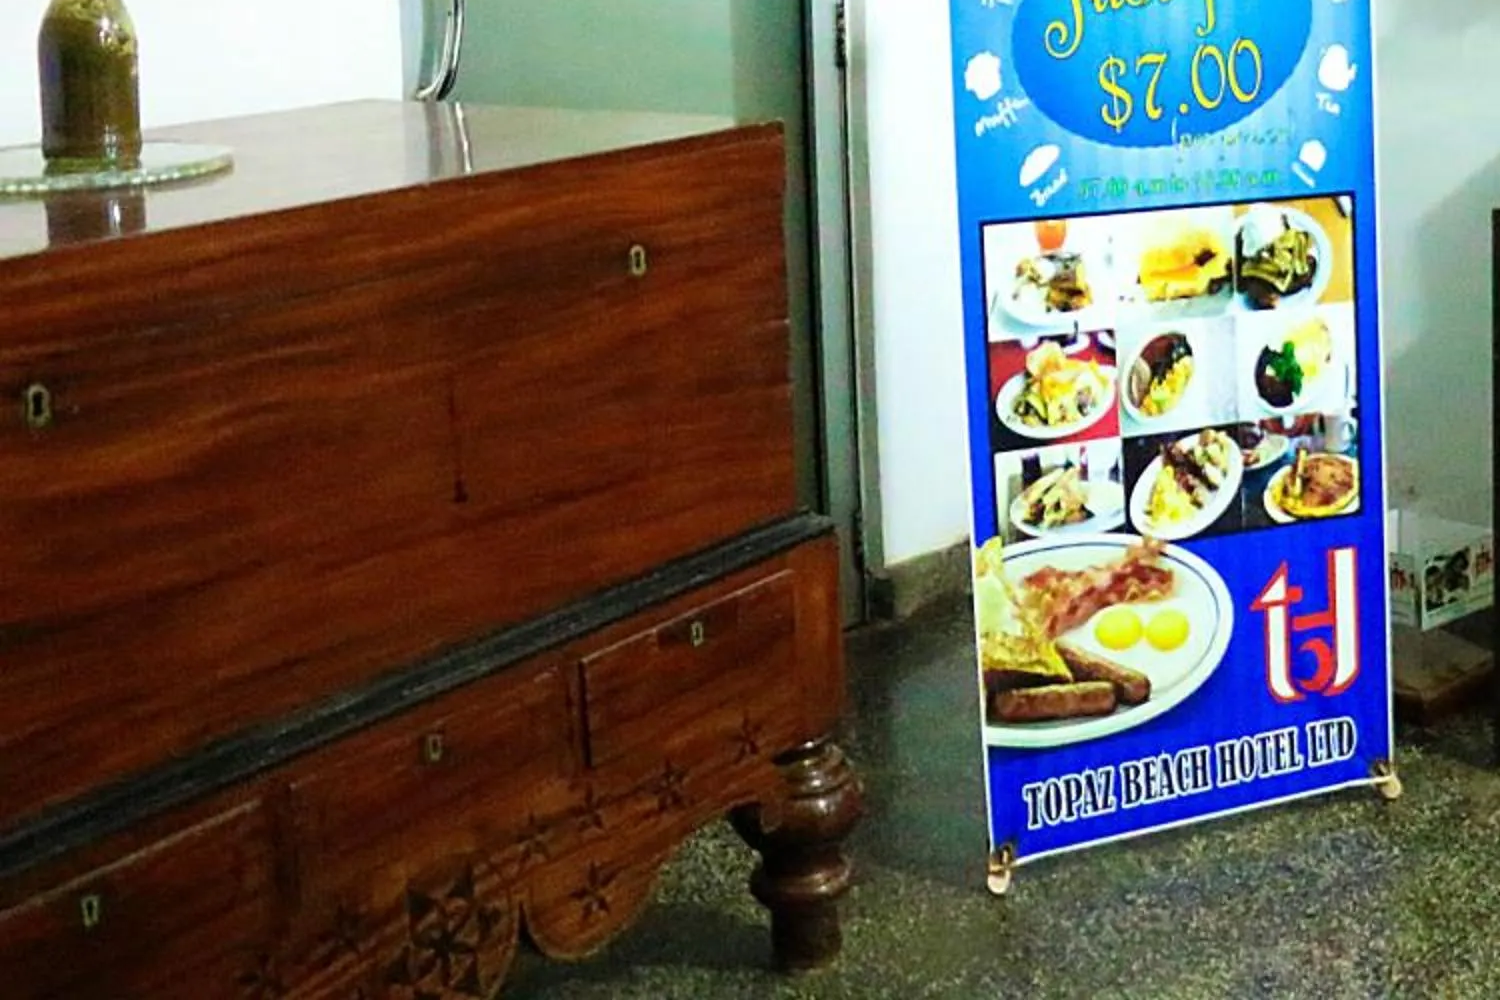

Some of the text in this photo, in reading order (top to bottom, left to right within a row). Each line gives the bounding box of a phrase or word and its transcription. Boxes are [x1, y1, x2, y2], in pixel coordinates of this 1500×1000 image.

[1098, 38, 1264, 134] $7.00
[1023, 716, 1358, 830] TOPAZ BEACH HOTEL LTD
